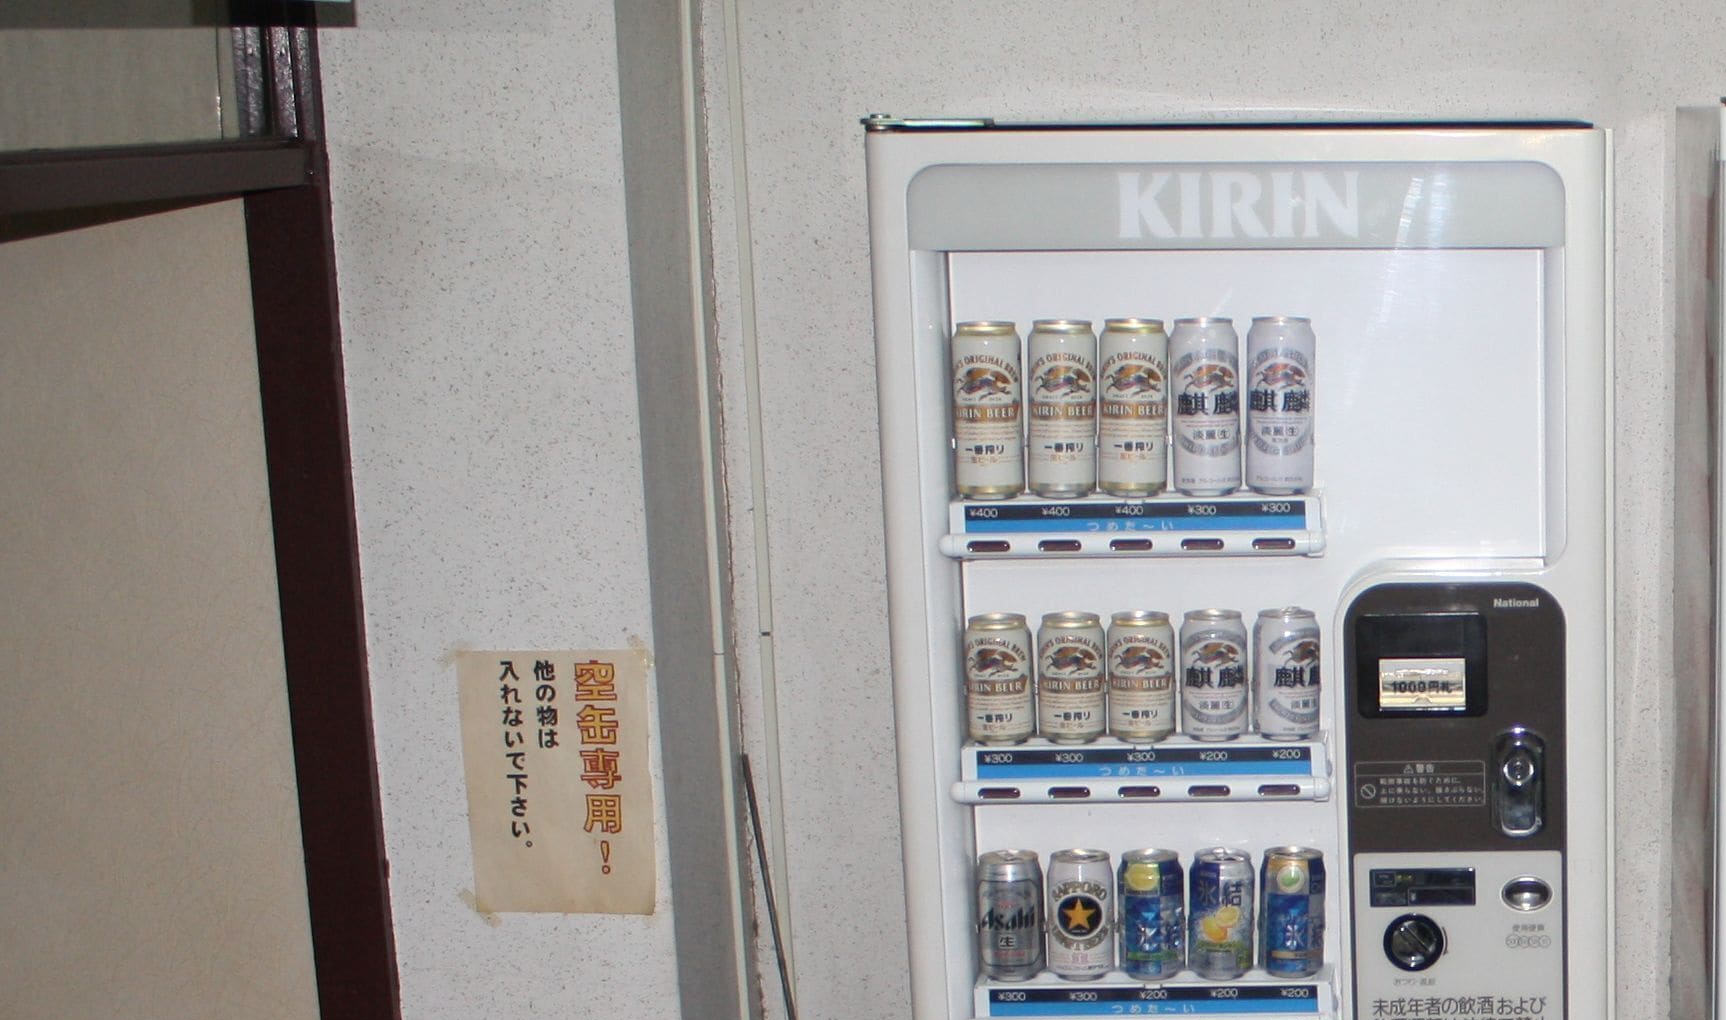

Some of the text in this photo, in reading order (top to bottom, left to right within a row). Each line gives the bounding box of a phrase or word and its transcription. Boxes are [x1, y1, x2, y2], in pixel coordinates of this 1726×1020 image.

[1116, 170, 1359, 240] KIRIN
[1177, 391, 1240, 416] 麒麟
[1249, 389, 1310, 413] 麒麟
[986, 407, 1015, 418] BEER
[1103, 403, 1164, 416] KIRIN BEER
[965, 444, 1005, 455] 一番搾り
[1045, 442, 1084, 454] 一番搾り
[1113, 441, 1154, 451] 一番搾り
[969, 503, 1290, 518] ¥400 ¥400 ¥400 ¥300 ¥300
[1493, 598, 1540, 608] National
[1185, 665, 1245, 688] 麒麟
[995, 681, 1022, 693] BEER
[1392, 680, 1453, 693] 1000円札
[533, 660, 560, 749] 他の物は
[976, 712, 1013, 723] 一番搾り
[1054, 711, 1091, 721] 一番搾り
[1122, 710, 1158, 719] 一番搾り
[499, 660, 533, 849] 入れないで下さい。
[985, 749, 1301, 763] ¥300 ¥300 ¥300 ¥200 ¥200
[982, 906, 1035, 931] Asahi
[1000, 936, 1016, 948] 生
[999, 988, 1309, 1001] ¥300 ¥300 ¥200 ¥200 ¥200
[1373, 996, 1547, 1016] 未成年者の飲酒および
